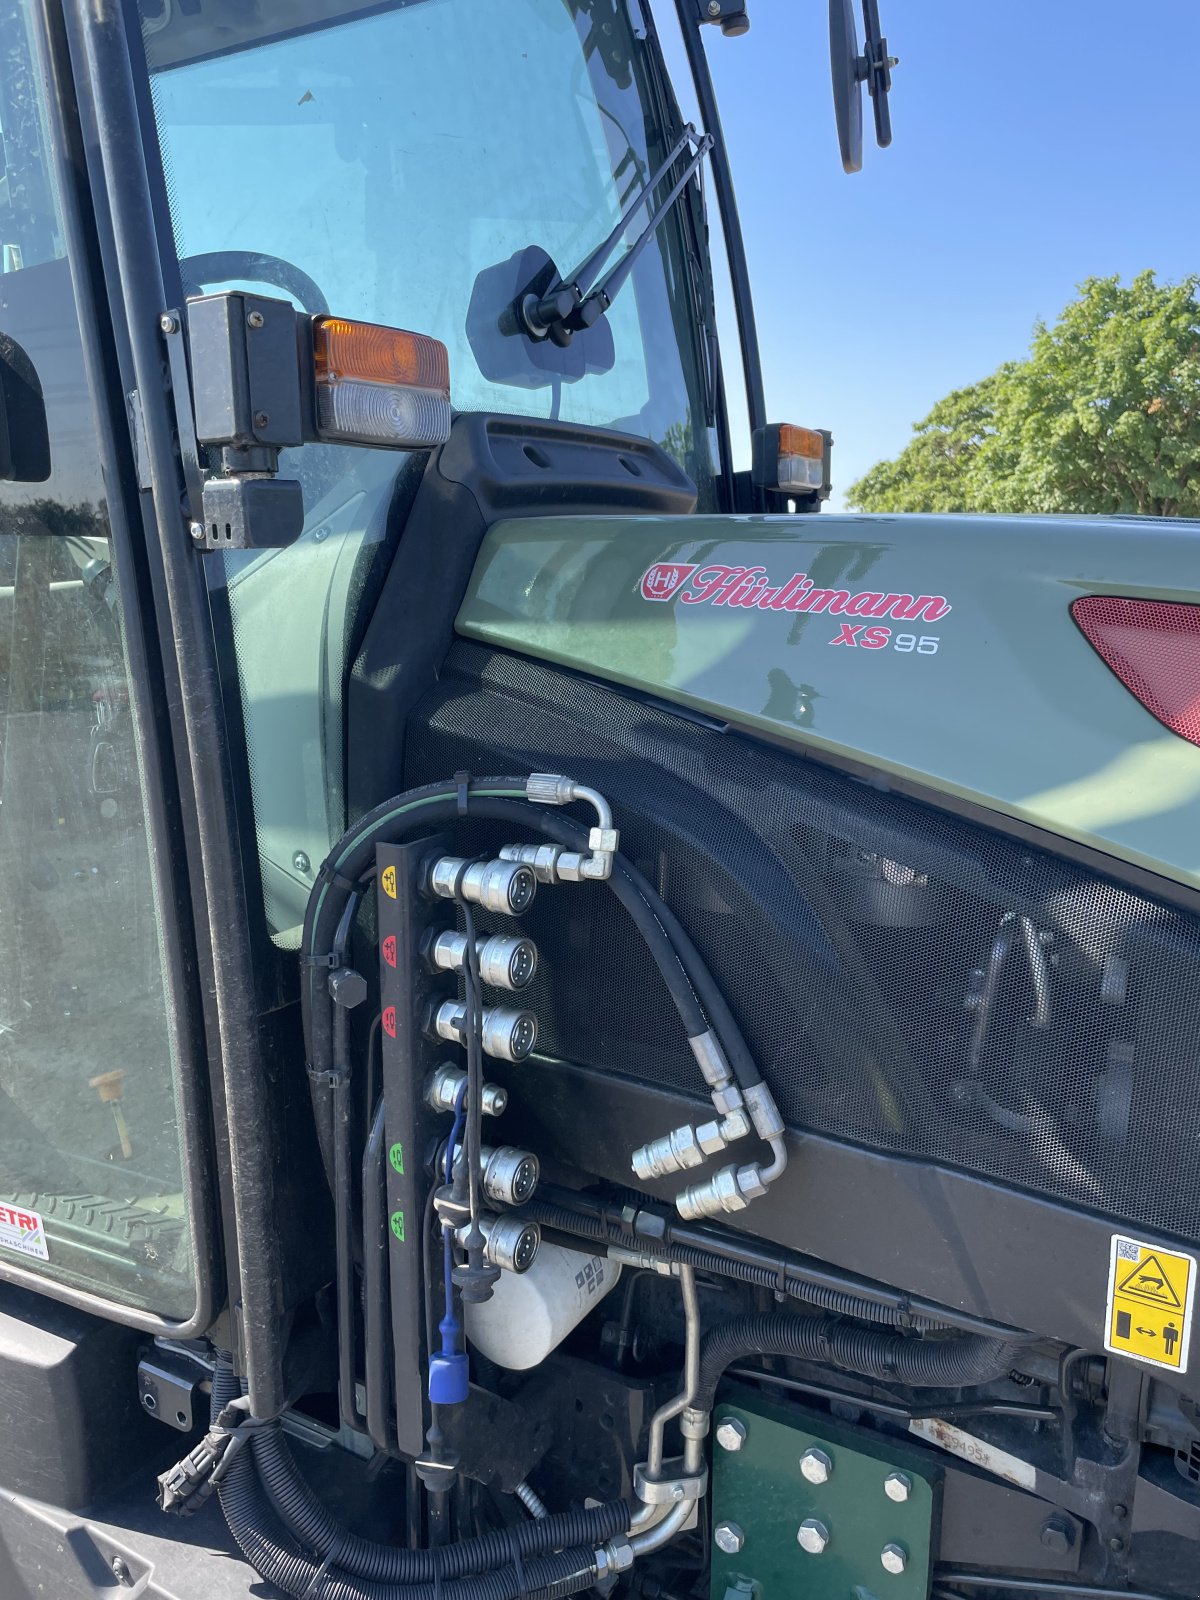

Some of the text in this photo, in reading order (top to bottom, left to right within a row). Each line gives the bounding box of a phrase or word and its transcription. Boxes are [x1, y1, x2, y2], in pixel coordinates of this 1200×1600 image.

[654, 571, 672, 588] H
[681, 565, 952, 622] Hürlimann
[828, 623, 940, 655] XS 95
